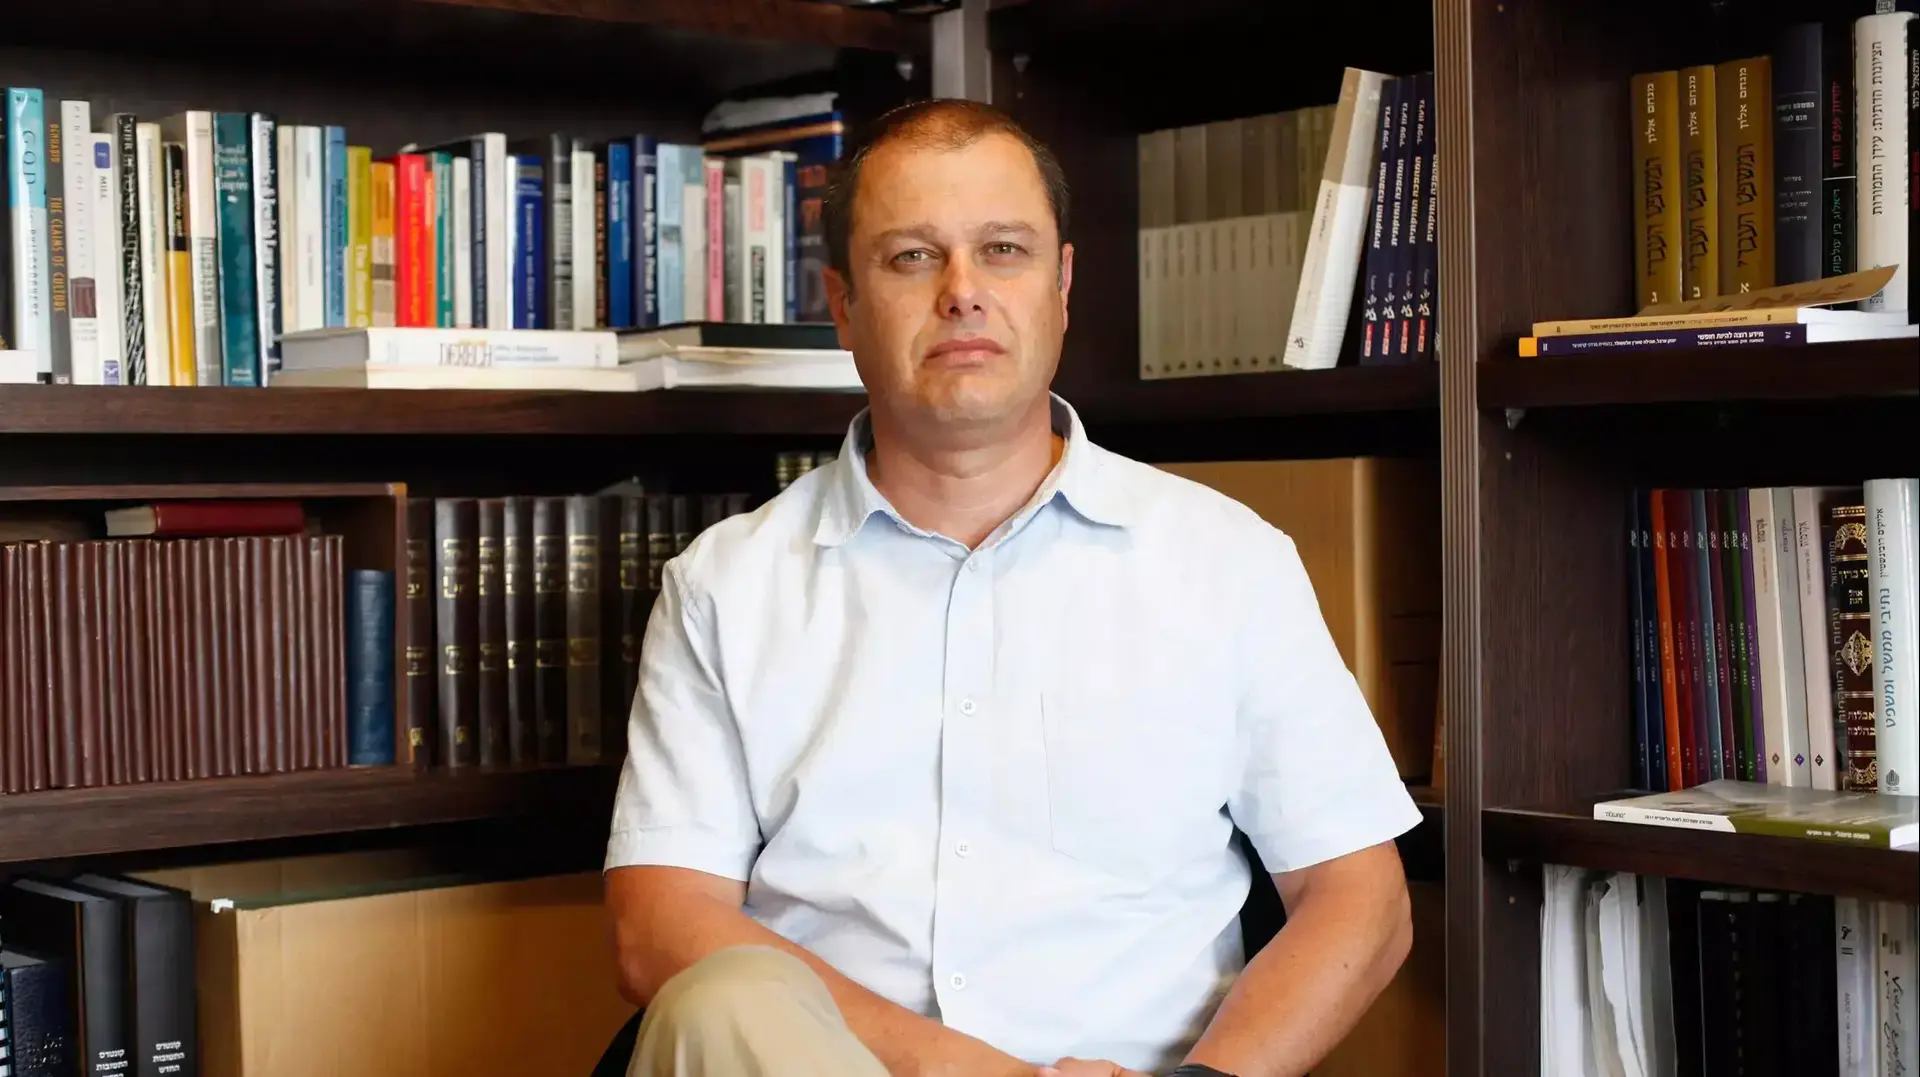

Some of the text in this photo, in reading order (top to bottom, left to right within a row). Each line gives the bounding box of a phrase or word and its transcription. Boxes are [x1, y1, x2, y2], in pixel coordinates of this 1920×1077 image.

[1872, 41, 1882, 85] הציונות
[1645, 83, 1657, 144] מנחם אלון
[1688, 75, 1699, 137] מנחם אלון
[1737, 67, 1749, 130] מנחם אלון
[22, 130, 36, 185] GOD
[1872, 136, 1884, 160] עידן
[1377, 162, 1387, 204] המהפכה
[1394, 159, 1404, 200] המהפכה
[1411, 156, 1422, 197] המהפכה
[1872, 165, 1883, 216] התמורות
[50, 197, 66, 313] THE CLAIMS OF CULTURE
[1876, 508, 1885, 536] אליקים
[1879, 587, 1896, 728] נתיבי ממשל ומשפט
[1848, 710, 1876, 721] אבלות
[1848, 726, 1876, 736] בהלכה
